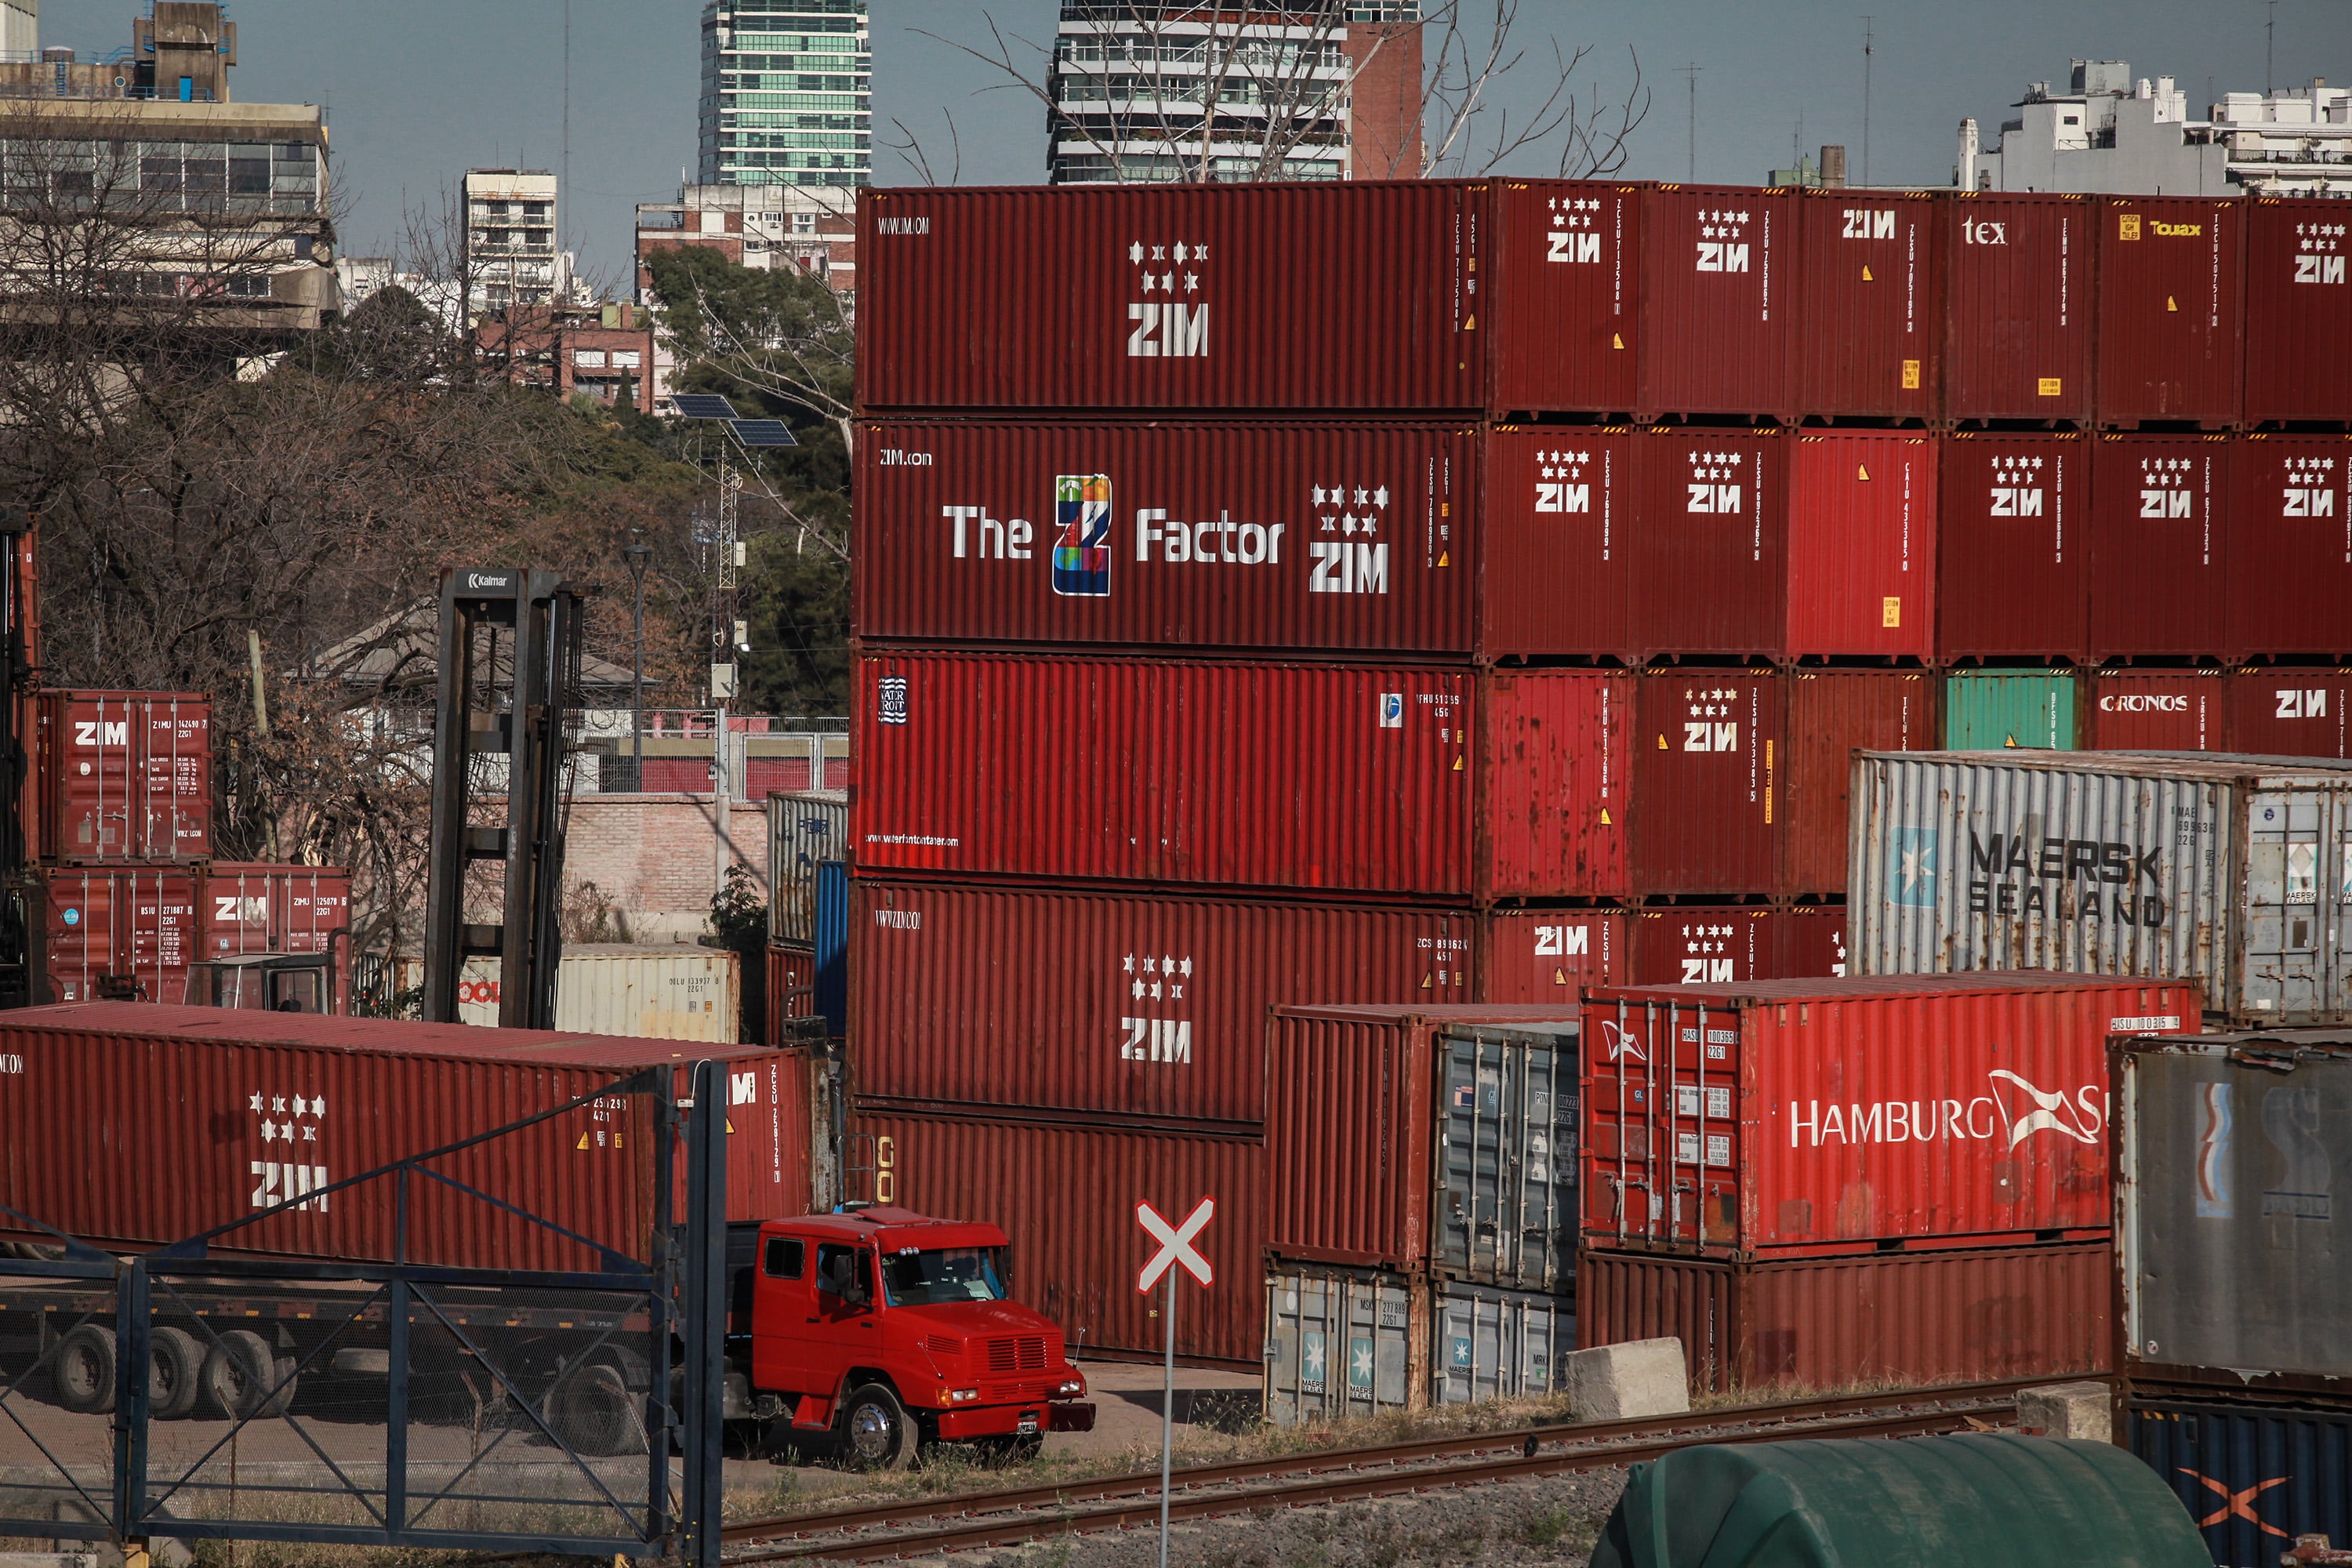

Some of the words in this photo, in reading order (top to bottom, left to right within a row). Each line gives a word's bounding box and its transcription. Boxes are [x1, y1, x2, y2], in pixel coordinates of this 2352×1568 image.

[1842, 209, 1895, 239] ZIM
[1962, 215, 2008, 245] tex
[2148, 220, 2203, 237] Touax
[1547, 227, 1600, 263] ZIM
[1696, 241, 1749, 273] ZIM
[2294, 255, 2346, 285] ZIM
[1127, 303, 1209, 358] ZIM
[1535, 483, 1589, 514] ZIM
[1687, 484, 1741, 514] ZIM
[1990, 488, 2042, 517] ZIM
[2140, 489, 2191, 518] ZIM
[2282, 488, 2334, 517] ZIM
[942, 506, 1033, 559] The
[1137, 509, 1285, 564] Factor
[476, 573, 507, 588] Kalmar
[1310, 542, 1389, 594] ZIM
[2100, 695, 2187, 712] CRONOS
[2276, 689, 2326, 718] ZIM
[74, 721, 126, 746] ZIM
[152, 720, 172, 729] ZIMU
[178, 720, 199, 728] 142490
[178, 729, 192, 738] 22G1
[1684, 722, 1737, 752] ZIM
[2177, 807, 2194, 818] MAE
[2177, 834, 2194, 846] 22G
[1970, 831, 2163, 888] MAERSK
[140, 906, 155, 916] BSIU
[162, 906, 184, 915] 271887
[293, 897, 310, 906] ZIMU
[316, 897, 337, 906] 125078
[316, 907, 330, 916] 22G1
[1970, 881, 2165, 928] SEALAND
[162, 916, 176, 925] 22G1
[1417, 938, 1434, 948] ZCS
[1534, 925, 1588, 956] ZIM
[1437, 951, 1452, 962] 451
[1681, 958, 1733, 985] ZIM
[1121, 1017, 1191, 1064] ZIM
[1709, 1031, 1733, 1044] 100365
[1708, 1046, 1725, 1058] 22G1
[1635, 1091, 1642, 1099] GL
[593, 1110, 610, 1123] 421
[1791, 1097, 1994, 1148] HAMBURG
[2078, 1085, 2110, 1134] S
[251, 1160, 328, 1213] ZIM
[1383, 1302, 1405, 1314] 277889
[1383, 1314, 1396, 1326] 22G1
